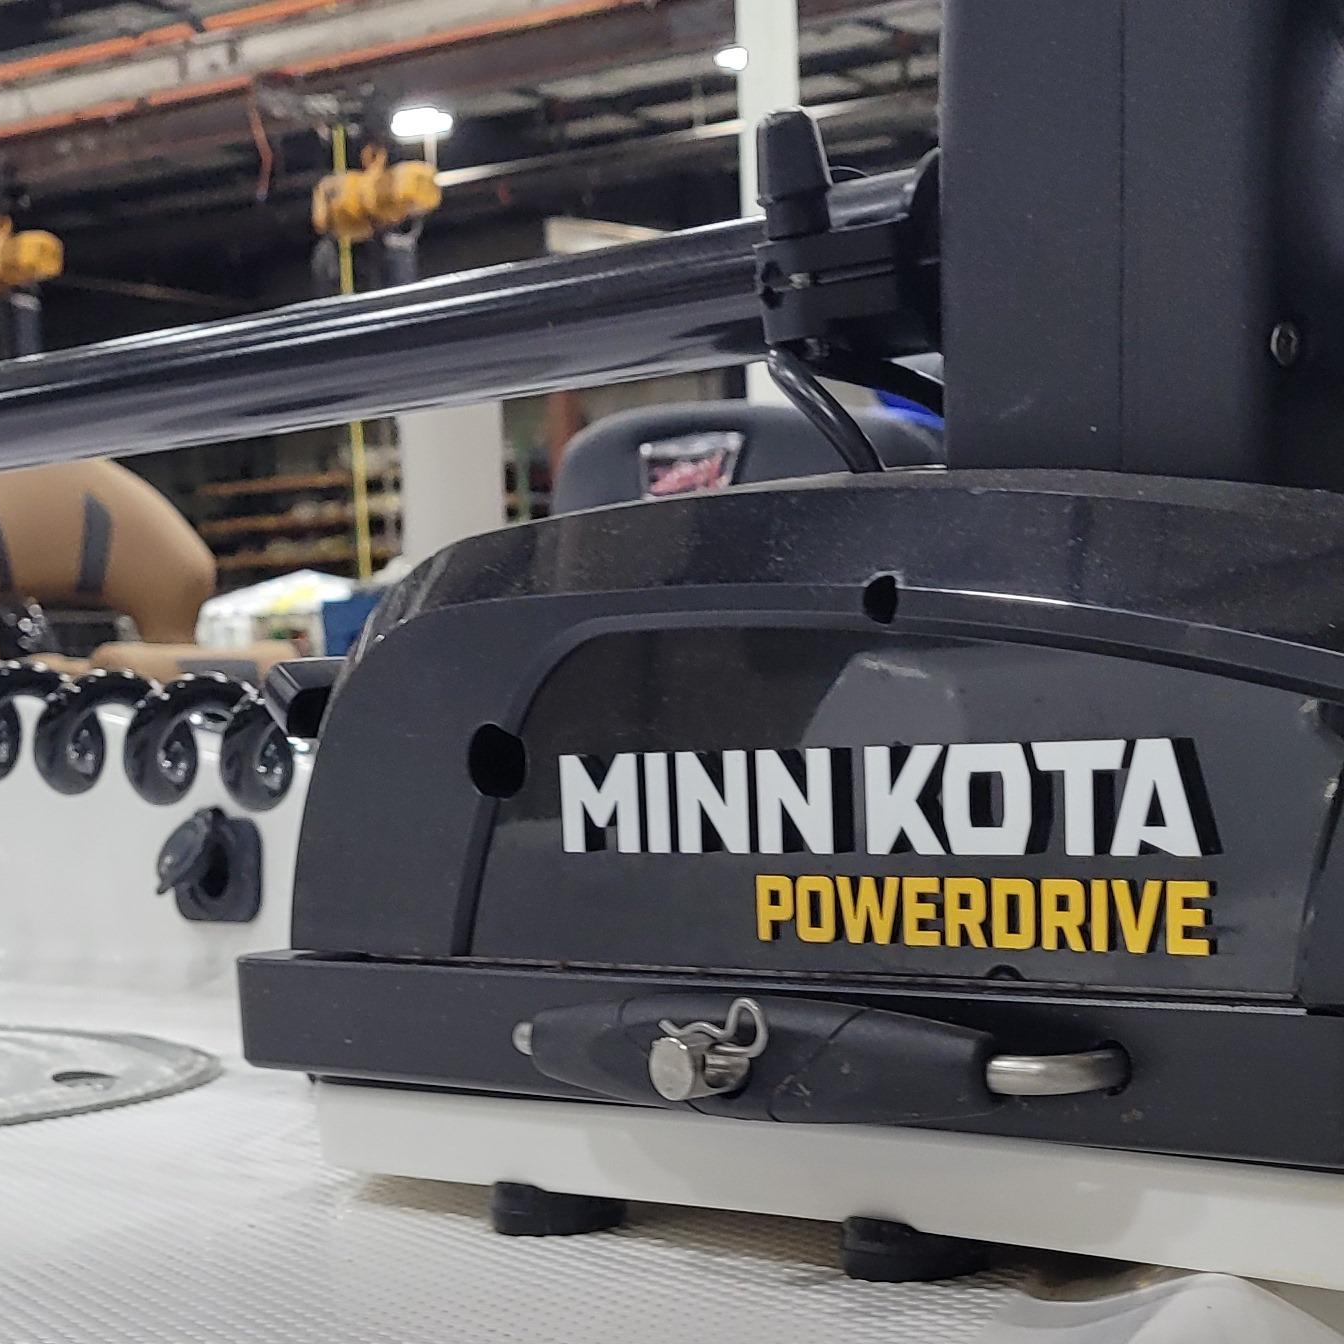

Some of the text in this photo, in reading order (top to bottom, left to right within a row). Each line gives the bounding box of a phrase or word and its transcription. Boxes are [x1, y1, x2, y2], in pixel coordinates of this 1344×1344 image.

[558, 737, 1208, 858] MINN KOTA
[755, 875, 1213, 956] POWERDRIVE
